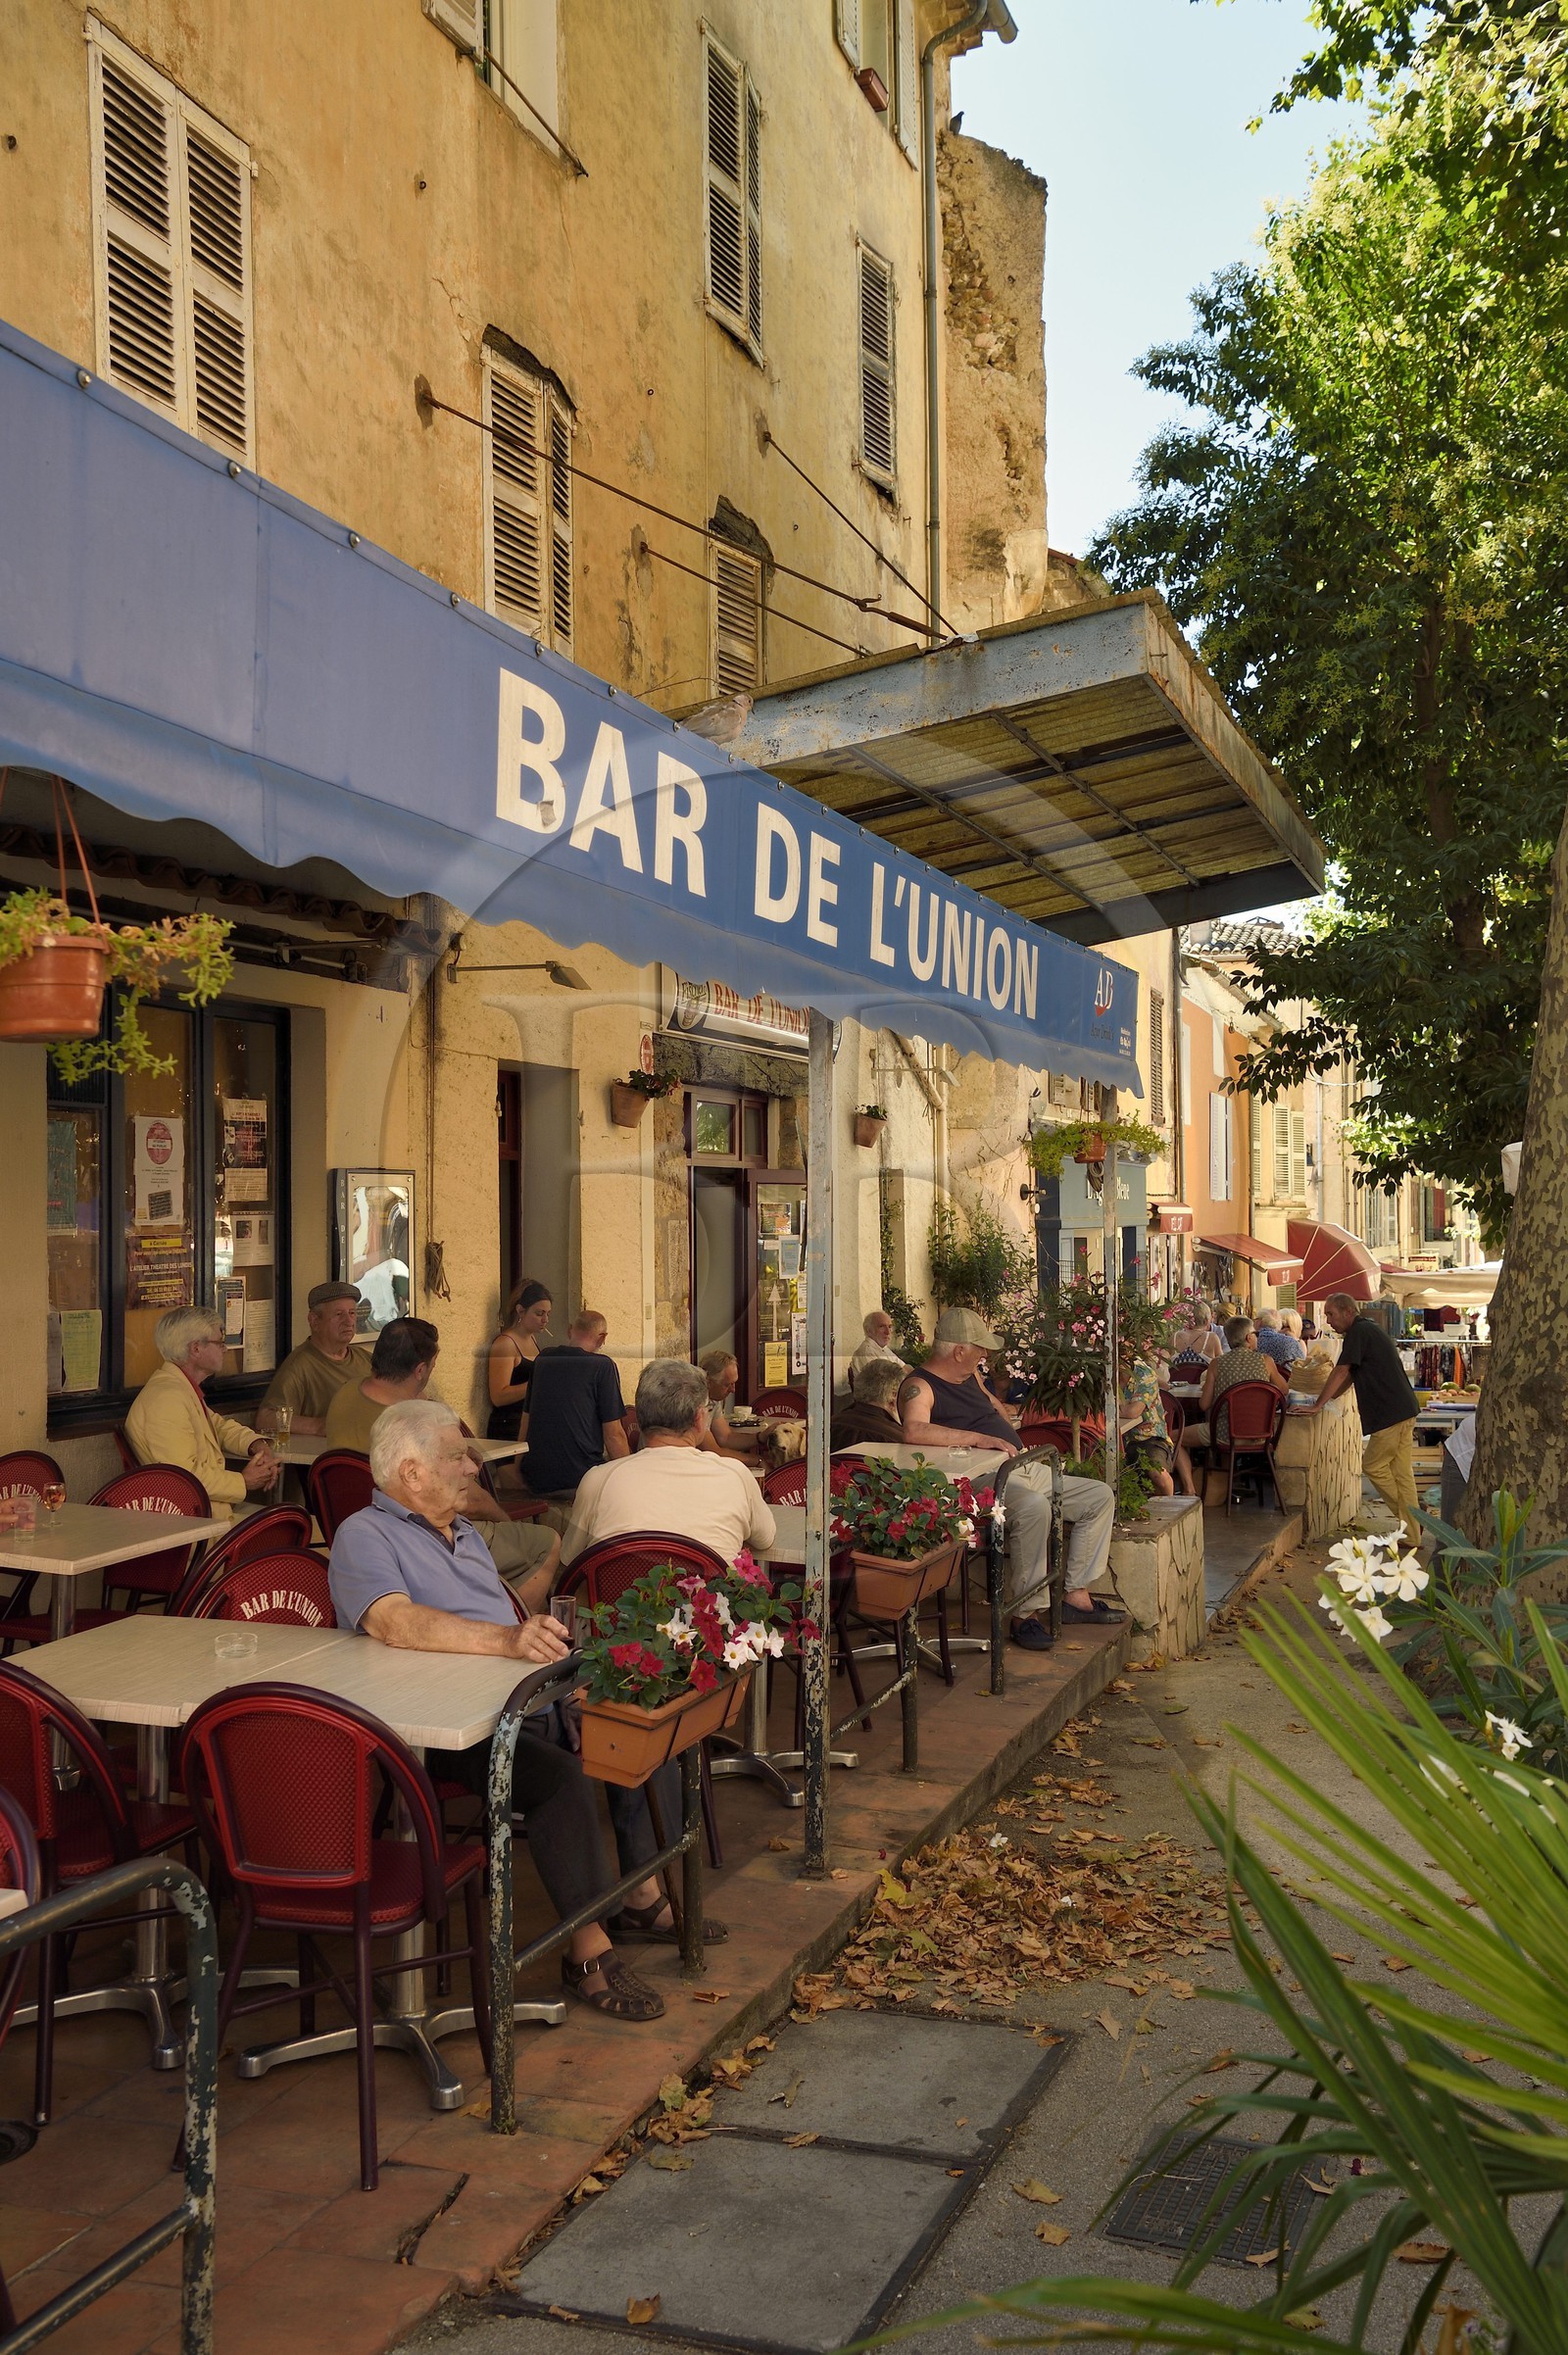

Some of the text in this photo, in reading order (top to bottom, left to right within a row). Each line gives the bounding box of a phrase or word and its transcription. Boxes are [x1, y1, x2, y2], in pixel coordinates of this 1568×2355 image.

[496, 666, 1040, 1019] BAR DE L'UNION
[713, 983, 810, 1036] BAR DE L'UNIO
[340, 1224, 345, 1245] DE
[142, 1496, 155, 1512] DE
[240, 1590, 324, 1628] BAR DE L'UNION
